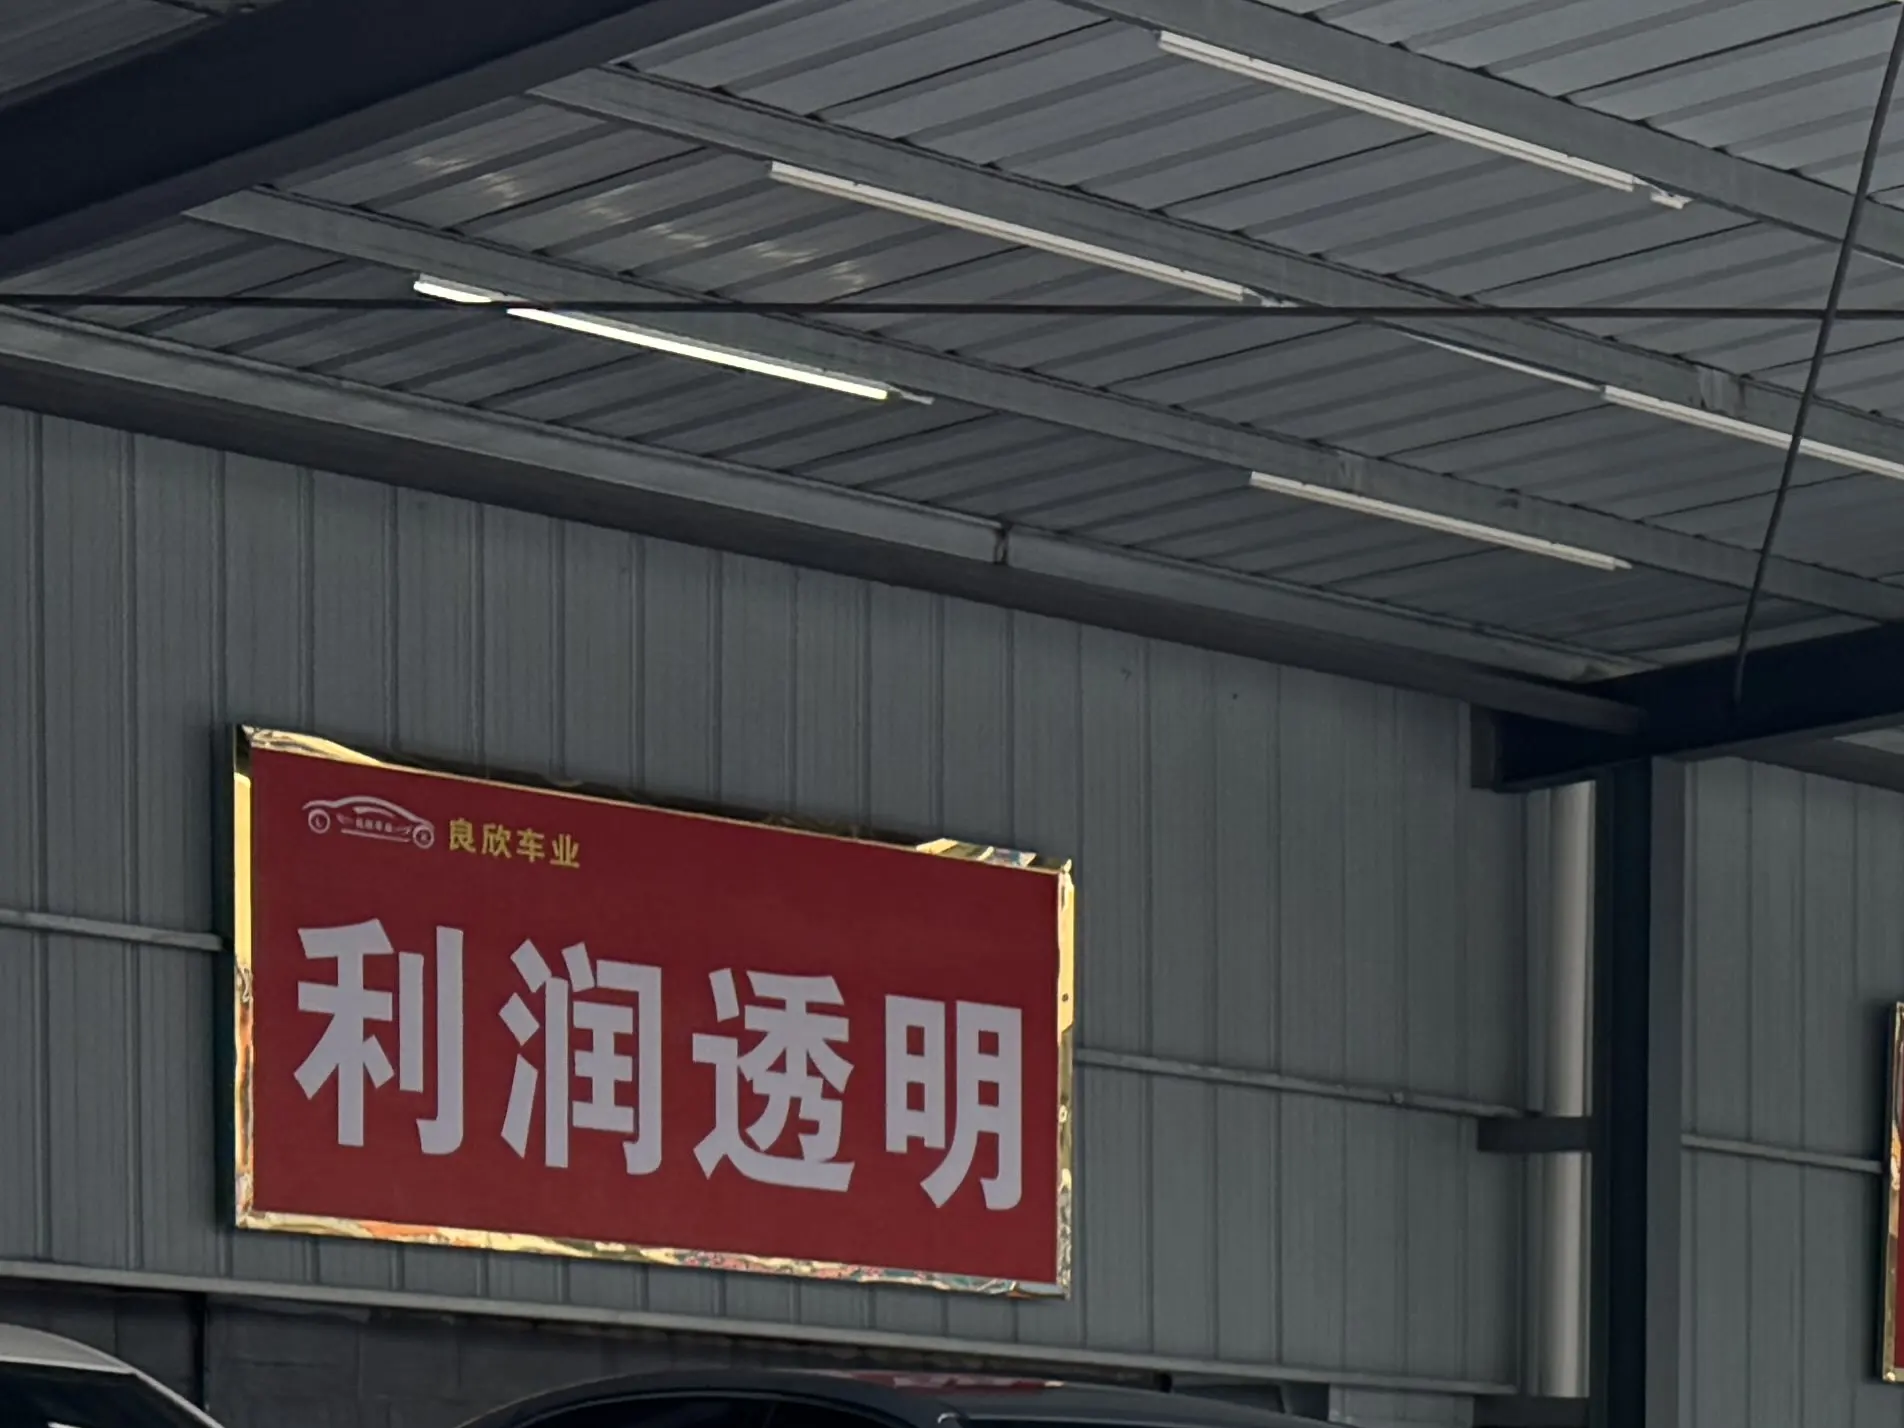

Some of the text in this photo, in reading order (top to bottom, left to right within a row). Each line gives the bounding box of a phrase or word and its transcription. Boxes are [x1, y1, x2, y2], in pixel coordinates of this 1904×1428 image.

[449, 817, 581, 868] 良欣车业
[295, 917, 1023, 1211] 利润透明
